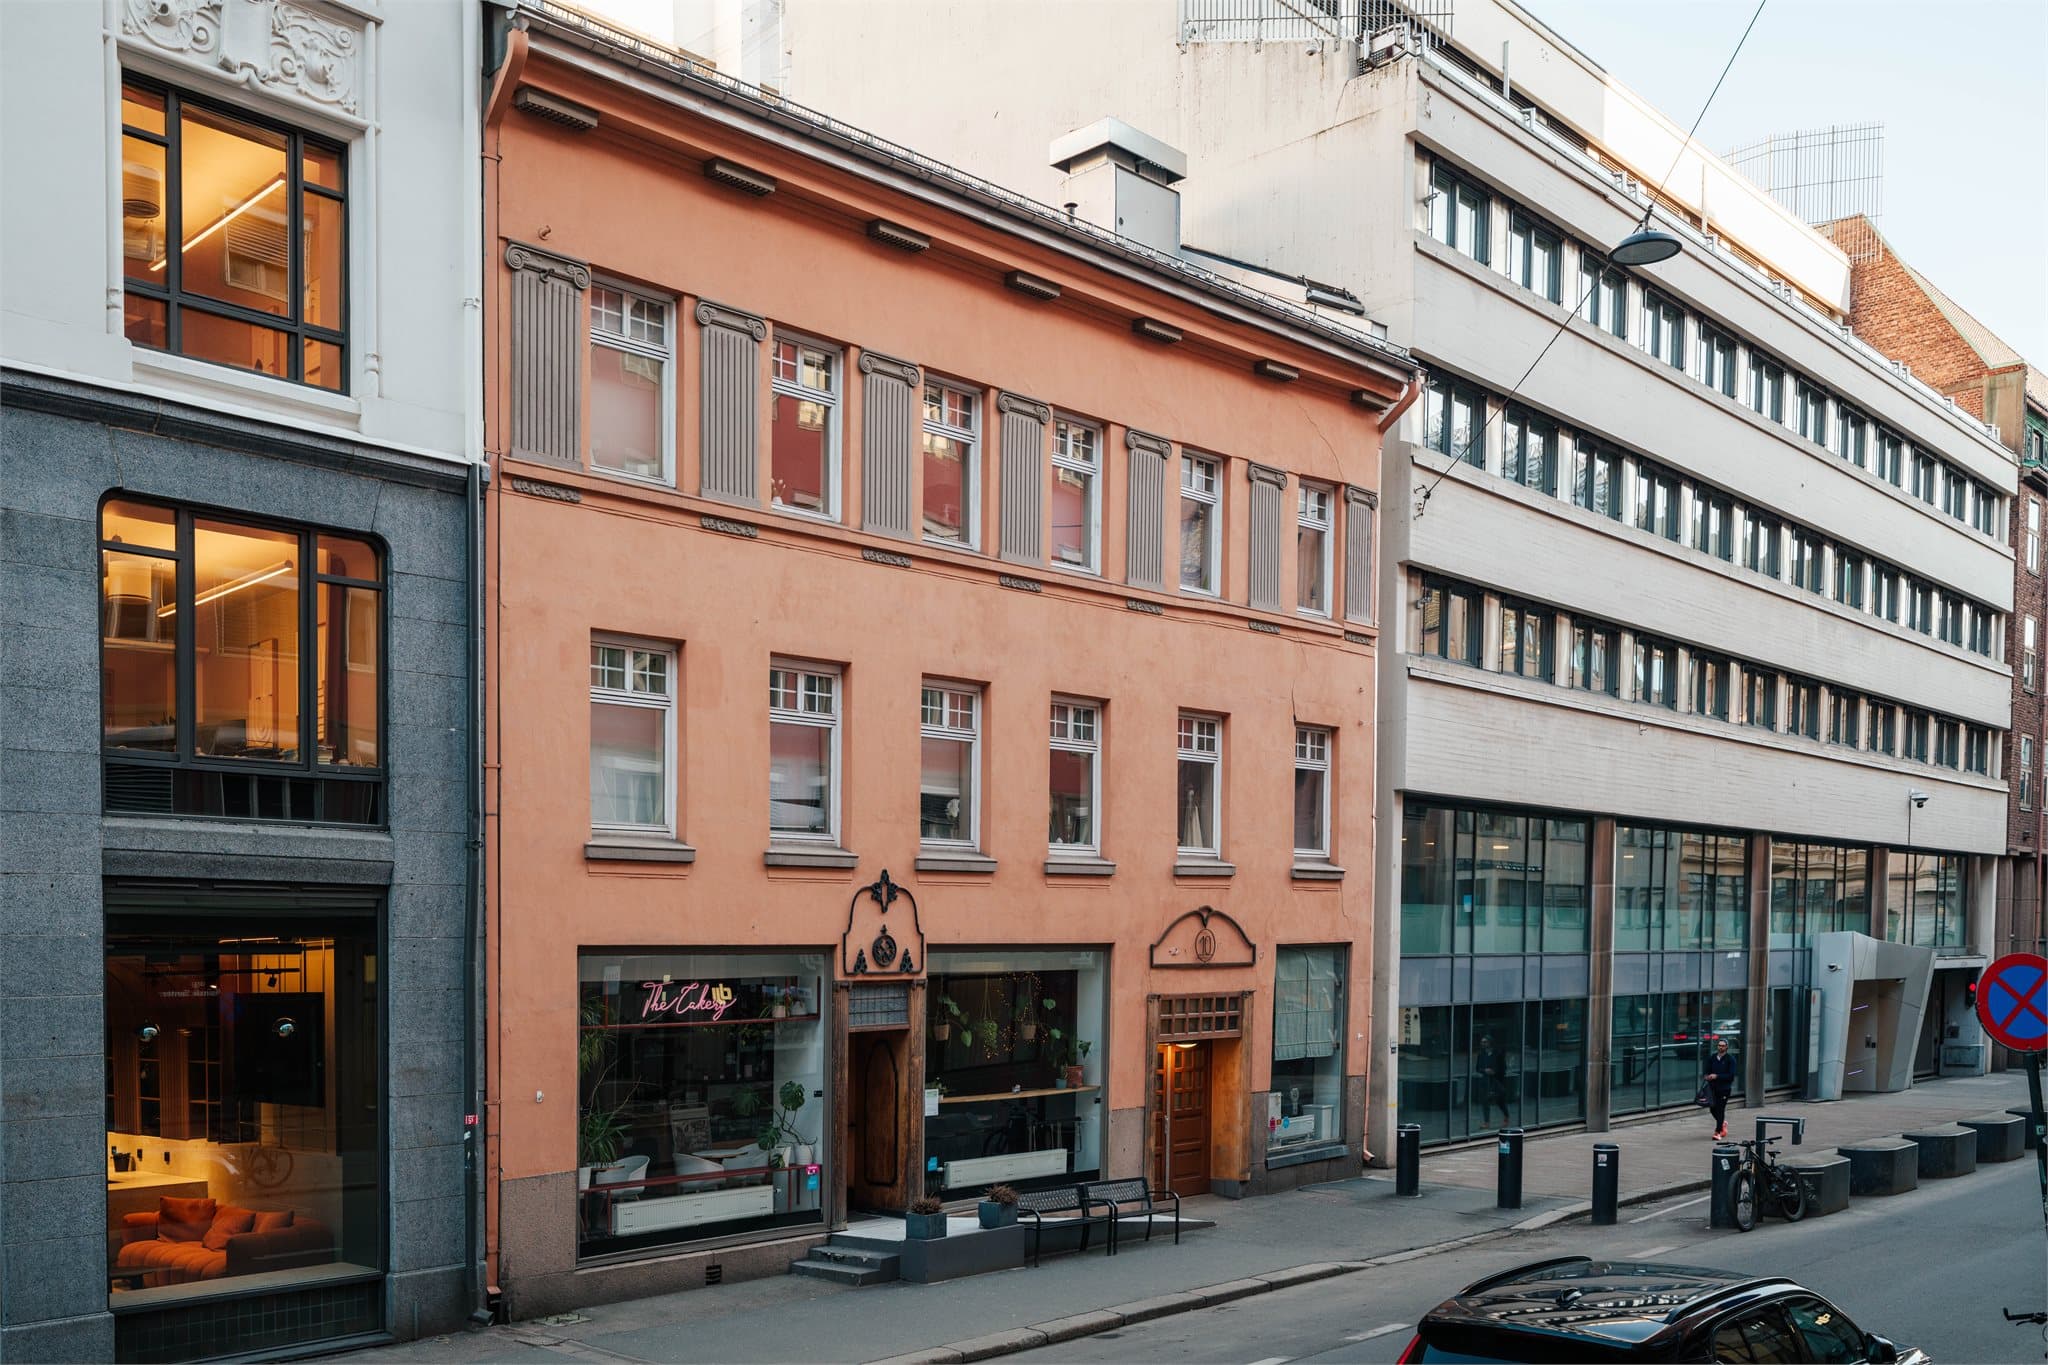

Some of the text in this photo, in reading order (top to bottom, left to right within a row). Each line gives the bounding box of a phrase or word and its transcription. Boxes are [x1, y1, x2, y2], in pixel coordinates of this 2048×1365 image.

[1199, 936, 1211, 956] 10
[642, 981, 678, 1018] The
[676, 983, 737, 1021] Cakery
